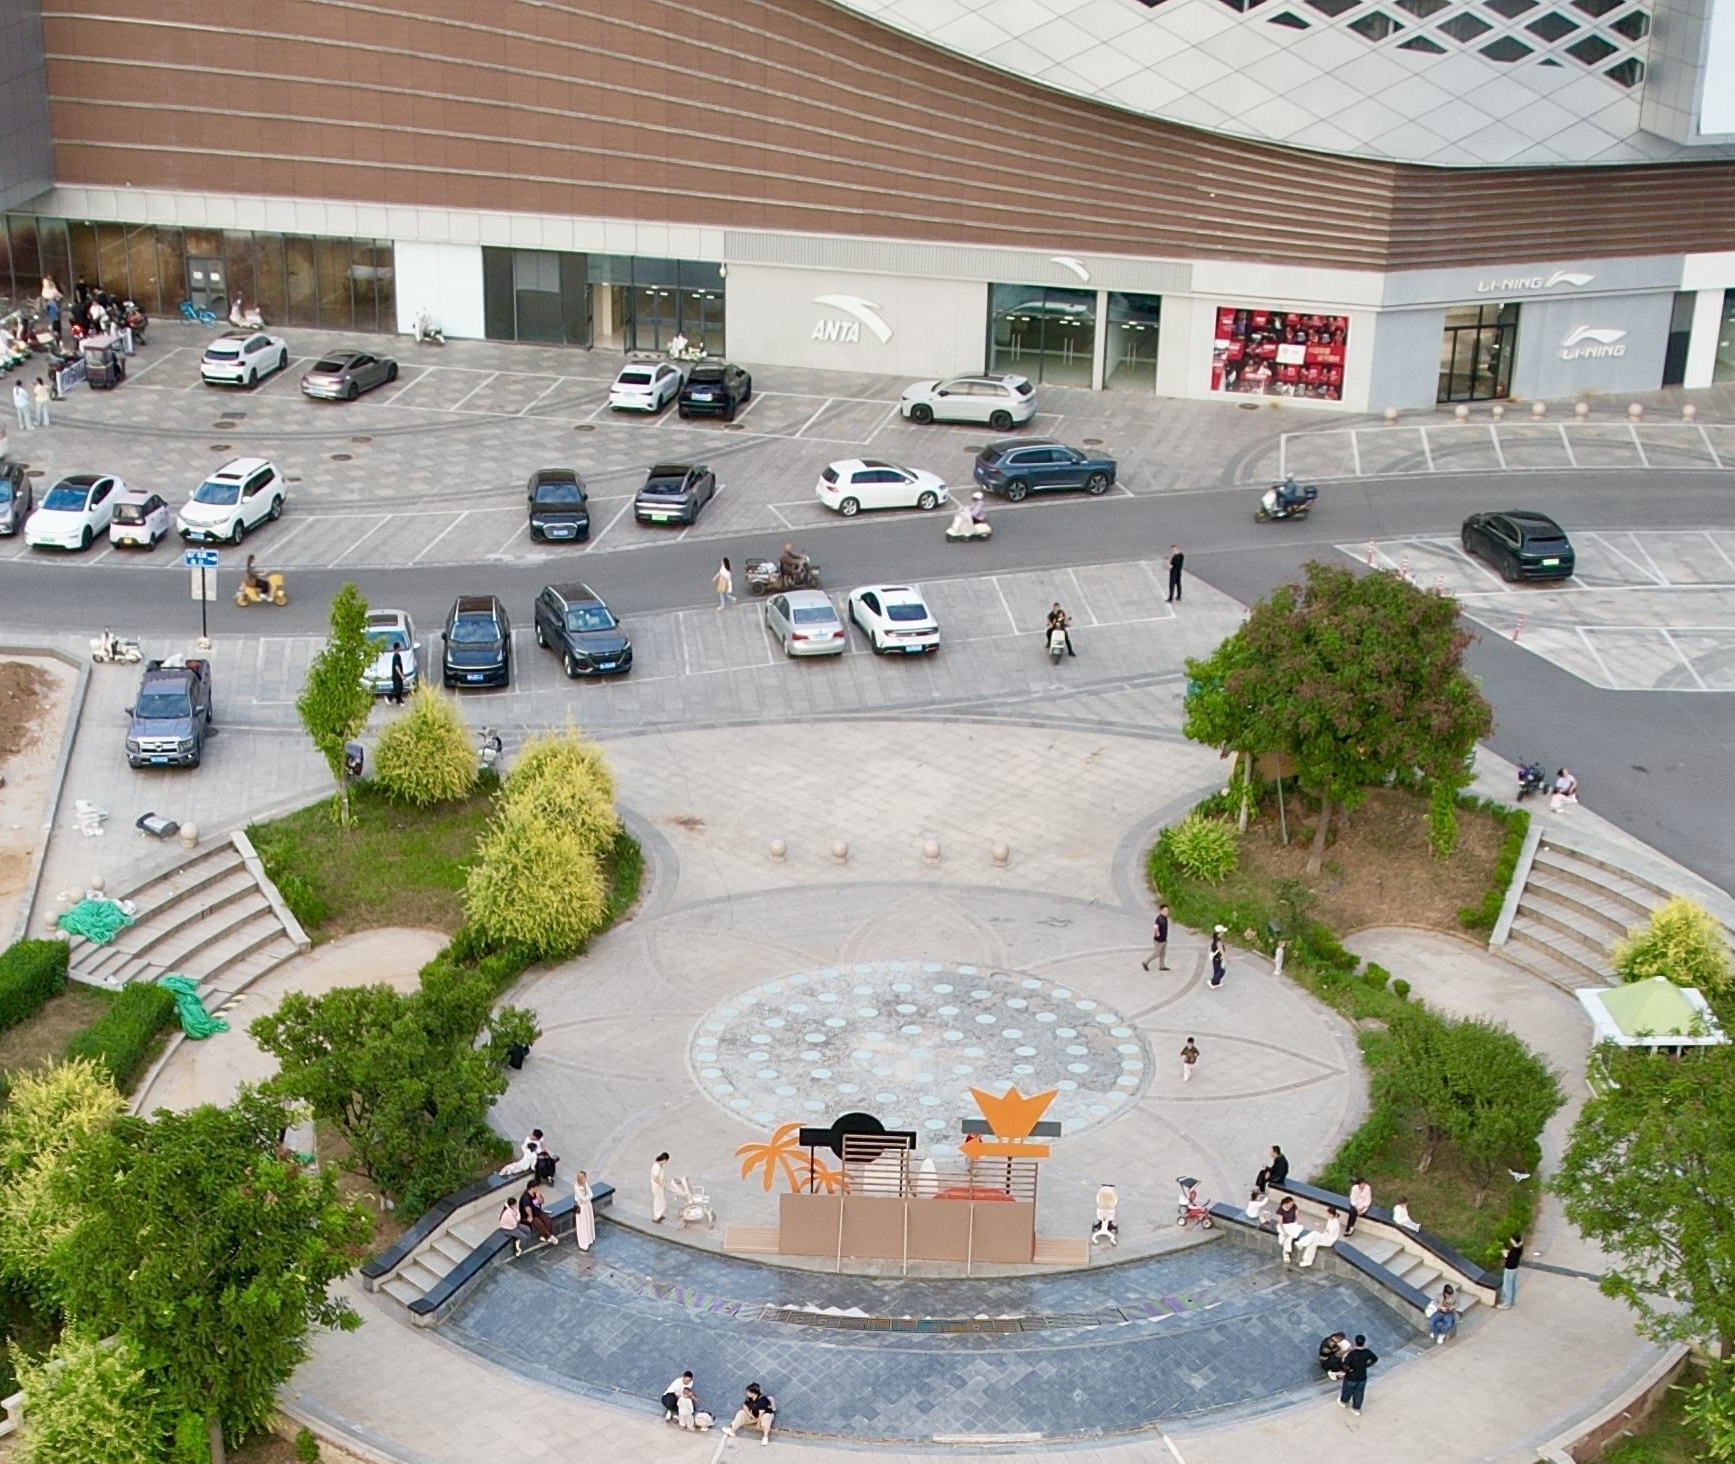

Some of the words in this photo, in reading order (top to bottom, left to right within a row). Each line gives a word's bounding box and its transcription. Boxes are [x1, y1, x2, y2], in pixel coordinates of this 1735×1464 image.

[1477, 276, 1544, 293] LI-NING
[810, 319, 862, 344] ANTA
[1561, 344, 1626, 360] LI-NING
